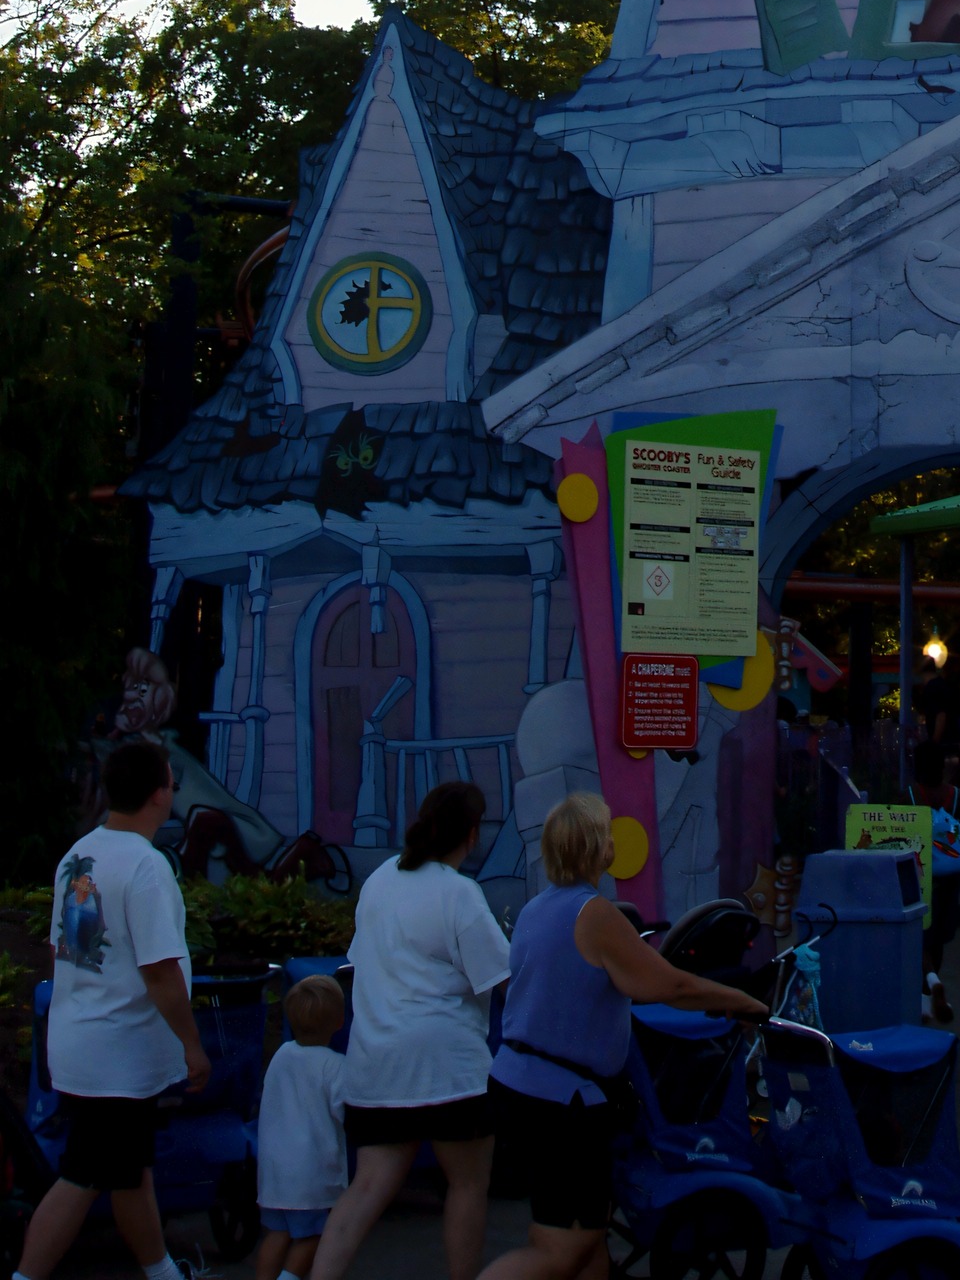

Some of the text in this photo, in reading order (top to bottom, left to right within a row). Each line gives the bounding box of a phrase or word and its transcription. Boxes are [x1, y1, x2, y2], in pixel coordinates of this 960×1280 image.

[632, 447, 691, 464] SCOOBY'S
[697, 453, 756, 470] Fun & Safety
[711, 467, 741, 479] Guide
[654, 574, 663, 587] 3
[861, 811, 917, 822] THE WAIT
